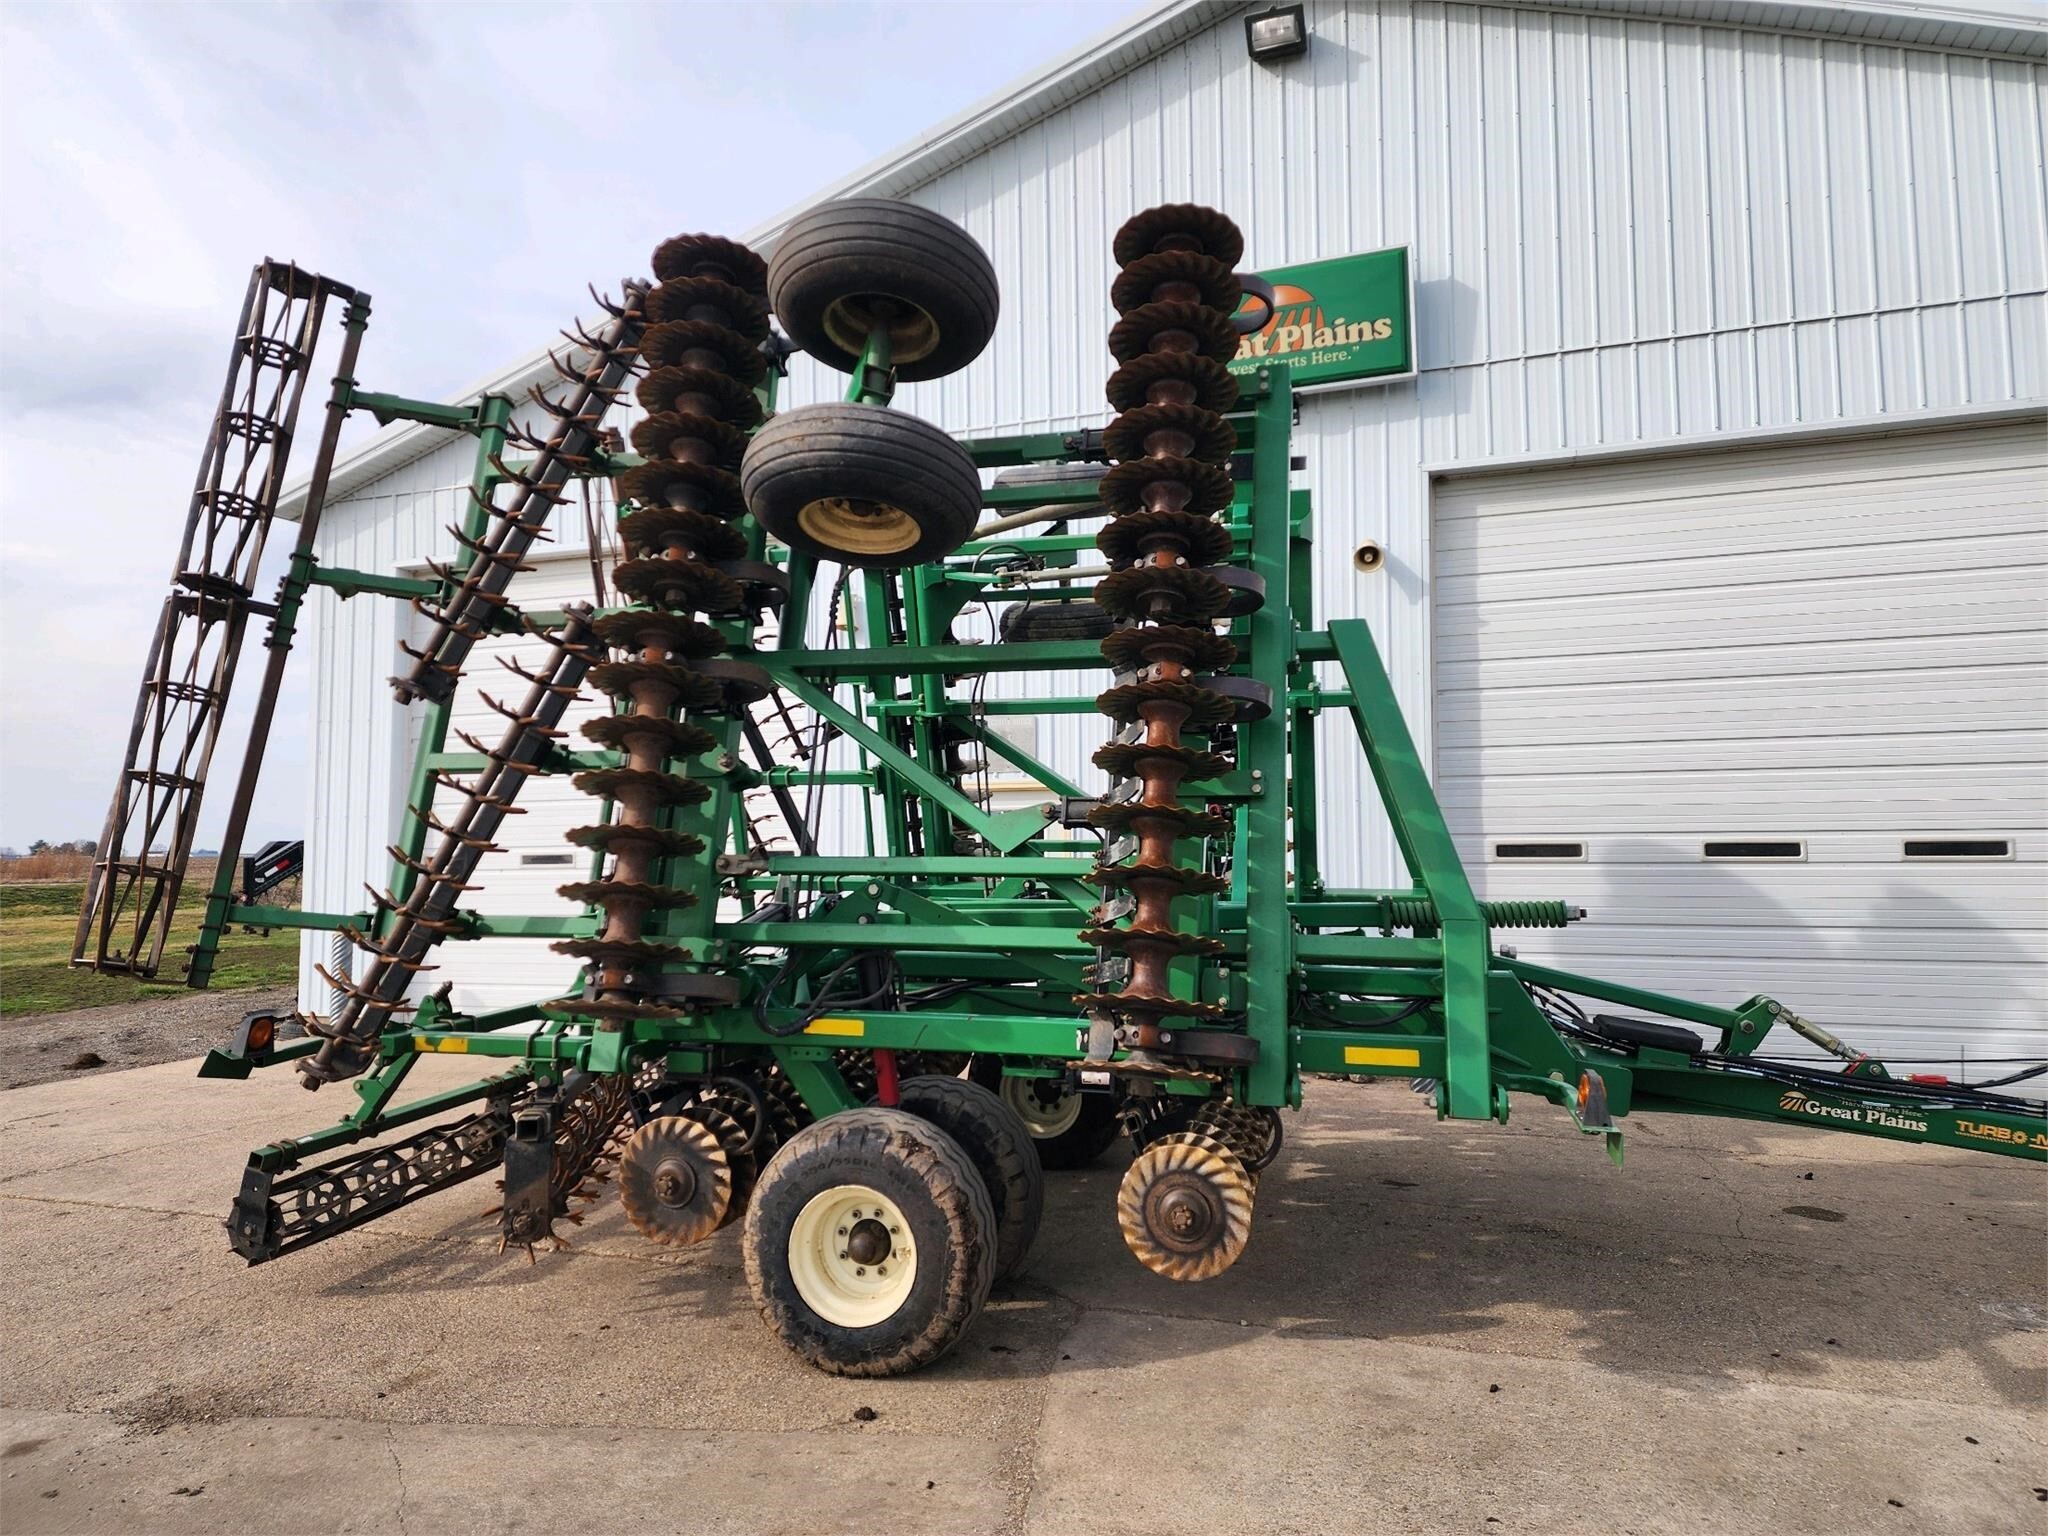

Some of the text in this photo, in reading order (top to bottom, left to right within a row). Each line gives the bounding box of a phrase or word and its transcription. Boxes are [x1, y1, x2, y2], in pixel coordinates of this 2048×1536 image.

[1276, 316, 1393, 354] Plains
[1804, 1100, 1929, 1132] Great Plains
